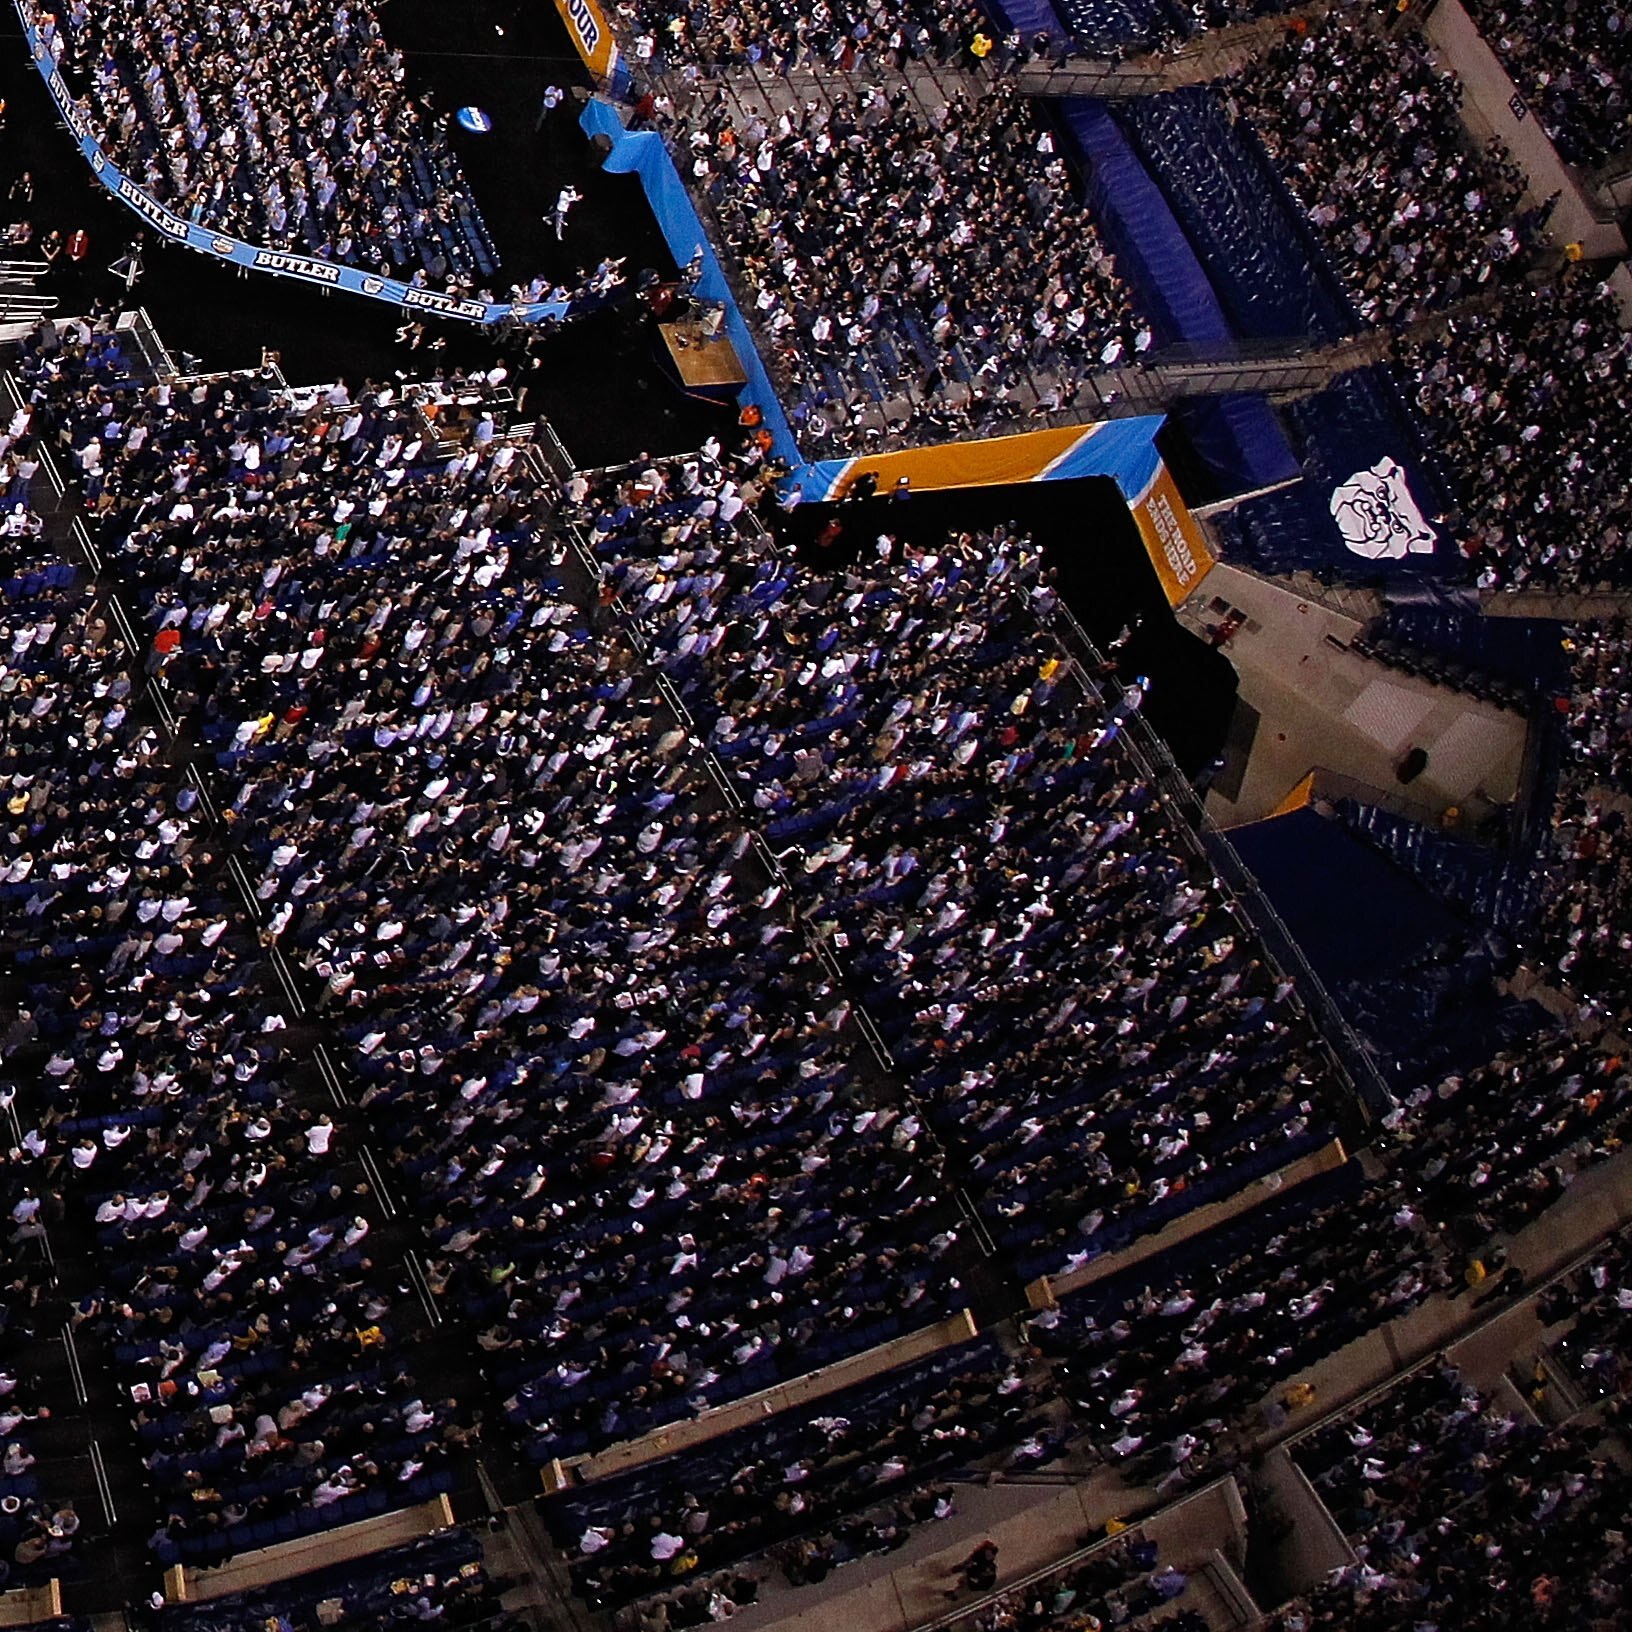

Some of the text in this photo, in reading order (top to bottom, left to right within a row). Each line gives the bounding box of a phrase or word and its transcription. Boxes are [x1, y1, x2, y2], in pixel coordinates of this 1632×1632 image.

[120, 179, 188, 238] BUTLER
[257, 252, 338, 282] BUTLER
[405, 289, 485, 319] BUTLER
[1172, 527, 1197, 575] ROAD
